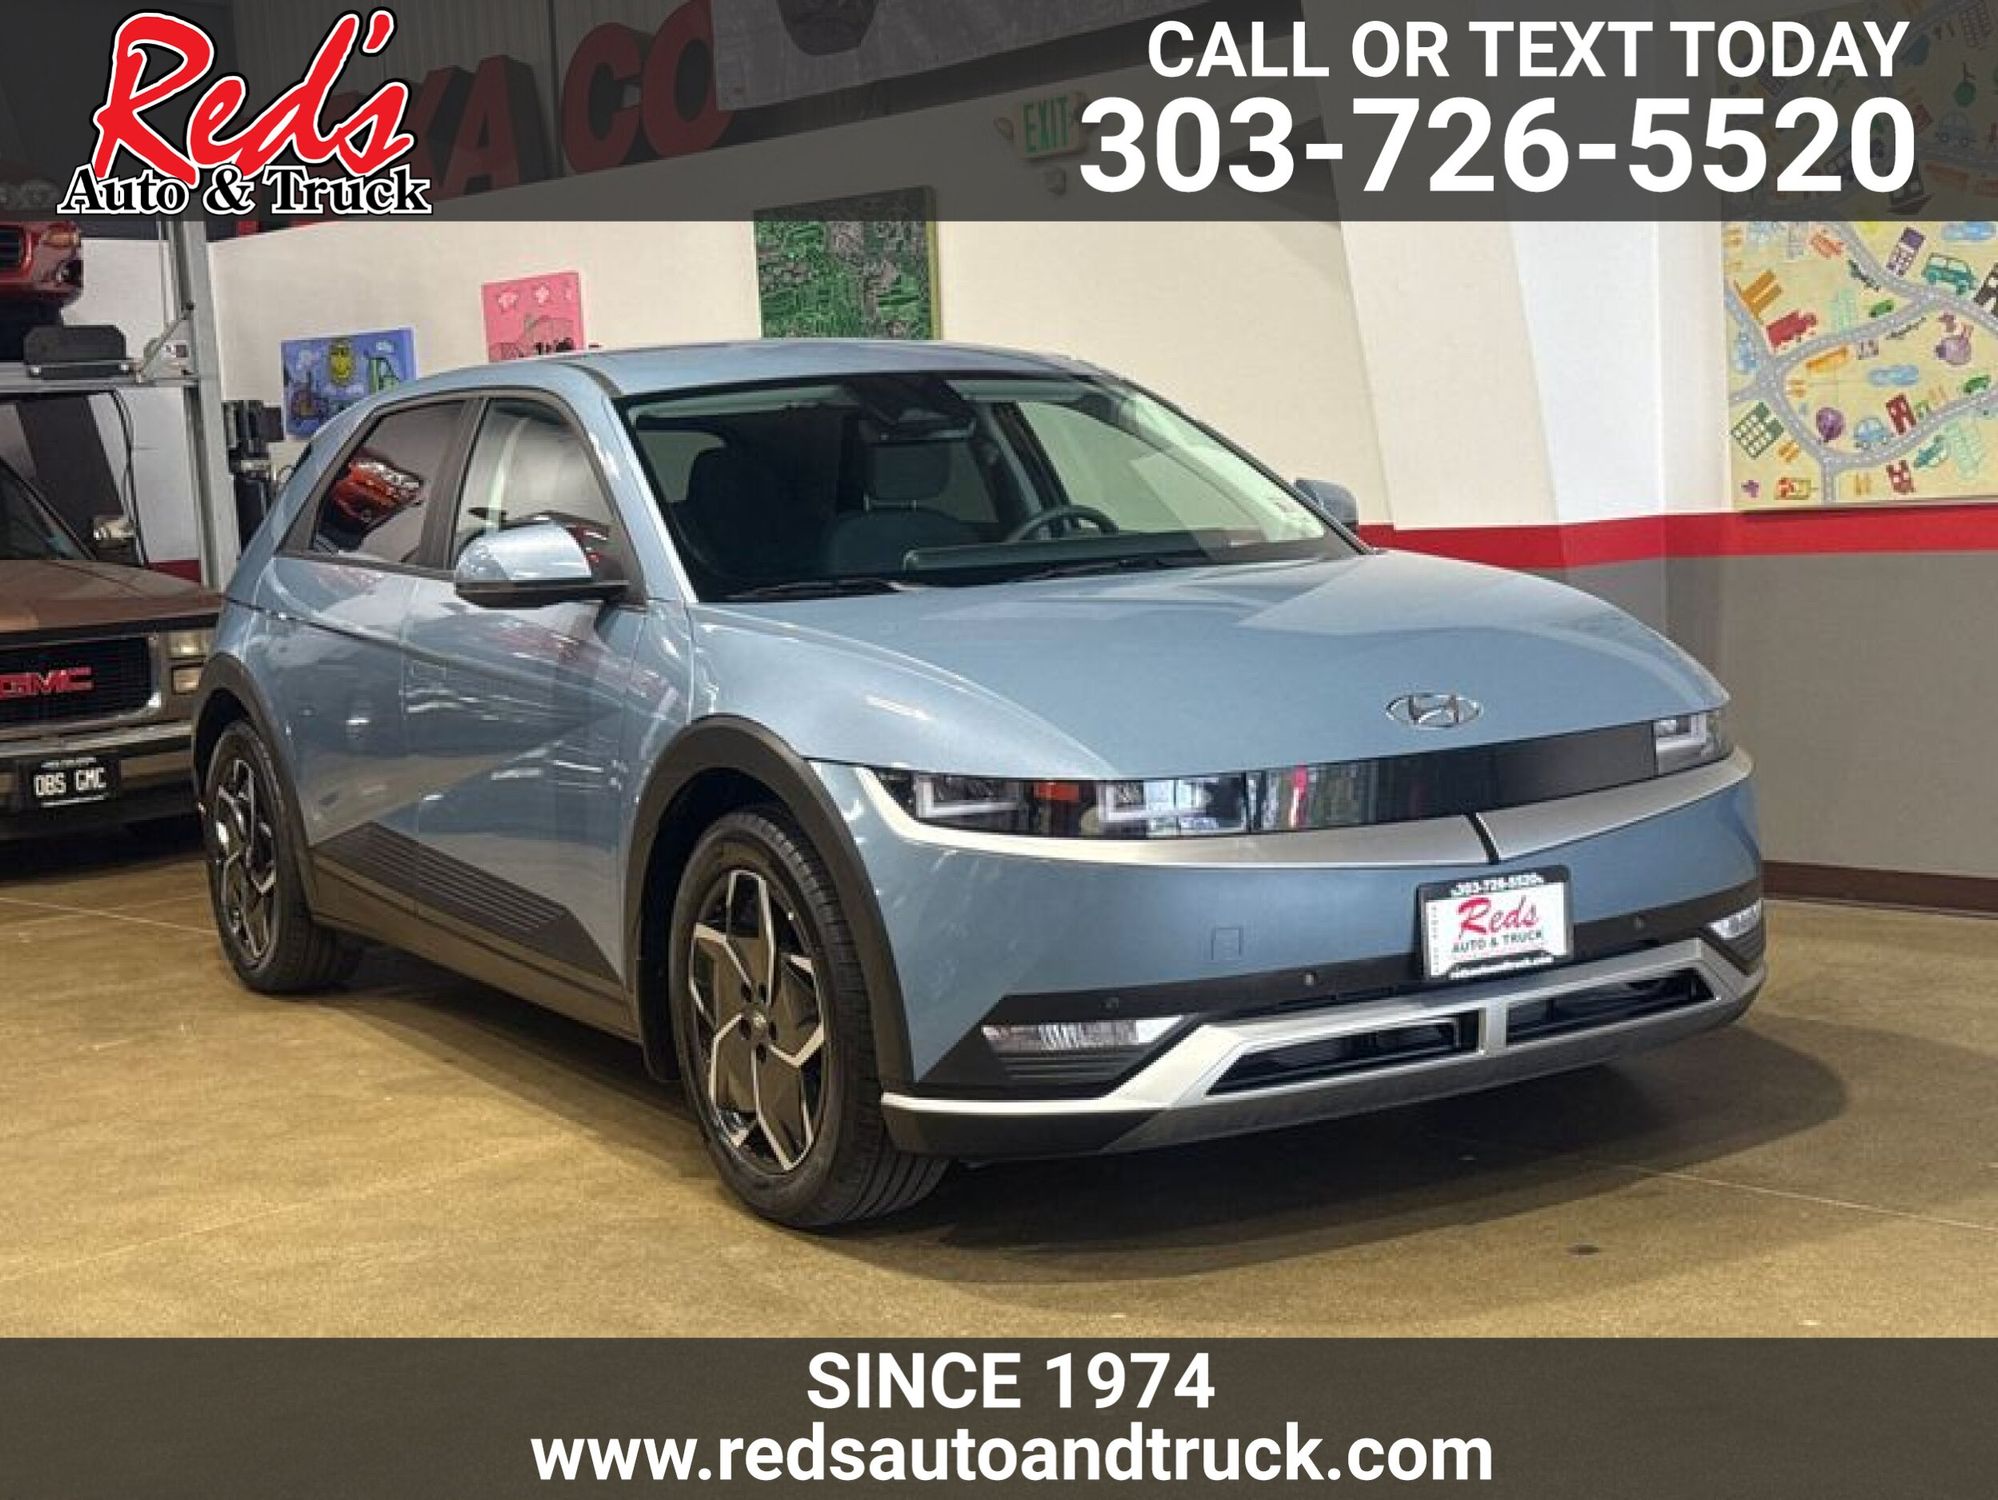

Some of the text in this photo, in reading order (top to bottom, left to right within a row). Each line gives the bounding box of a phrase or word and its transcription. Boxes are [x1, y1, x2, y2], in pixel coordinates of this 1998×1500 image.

[1023, 96, 1069, 153] EXIT
[0, 667, 93, 697] GMC
[1457, 894, 1539, 940] Reds
[1453, 937, 1487, 953] AUTO
[1503, 930, 1542, 946] TRUCK
